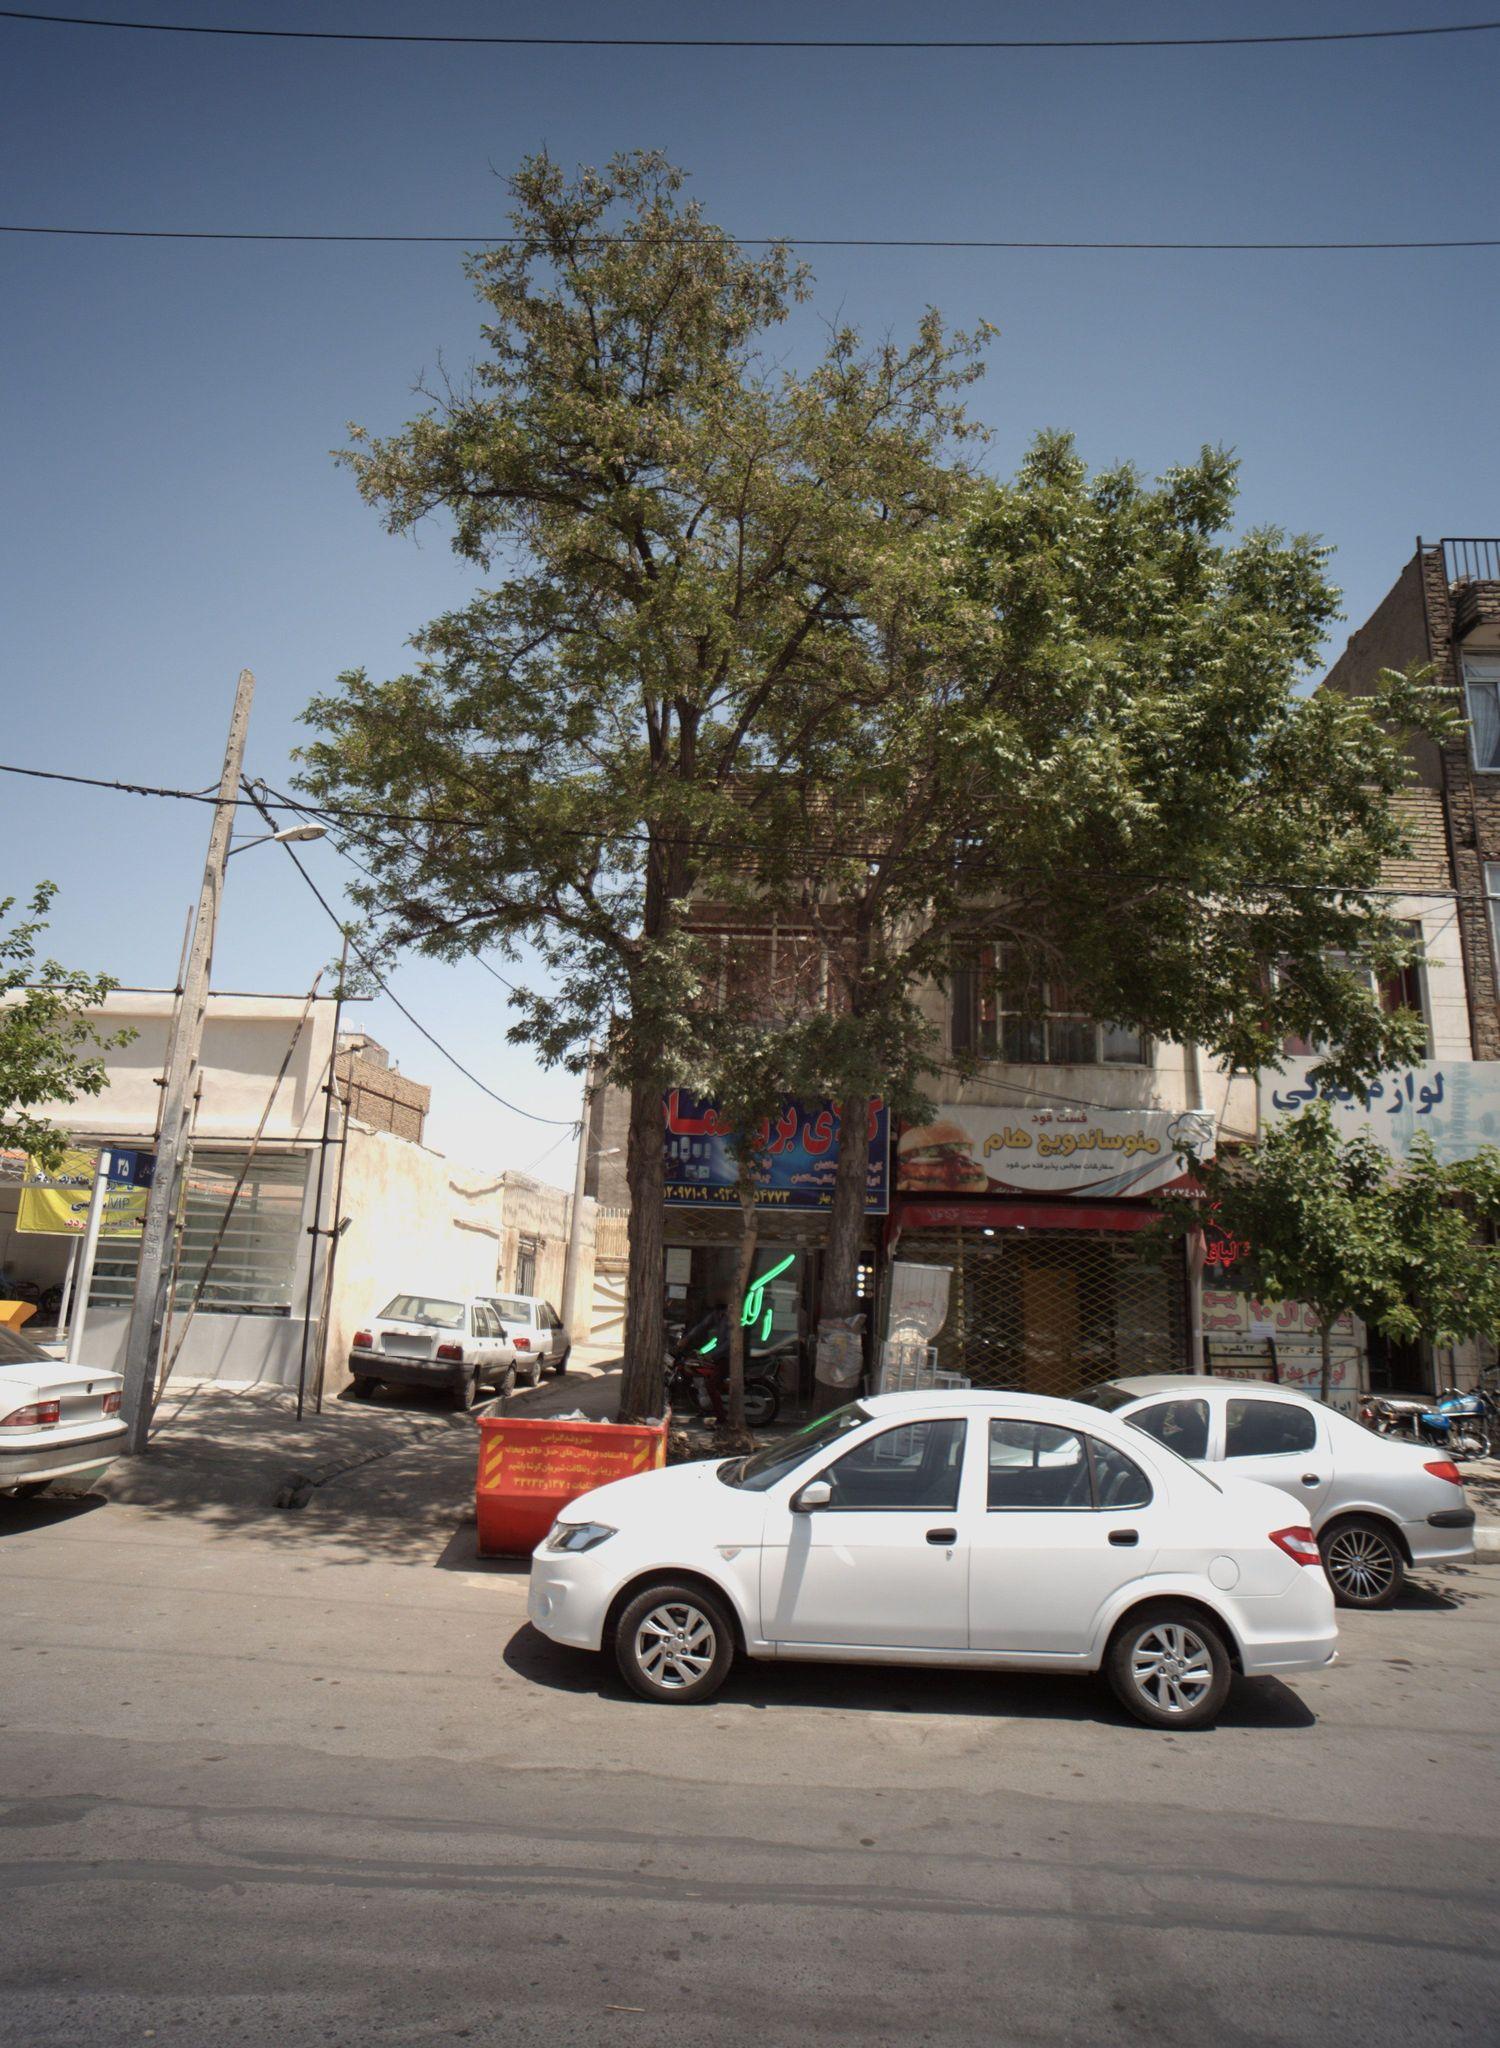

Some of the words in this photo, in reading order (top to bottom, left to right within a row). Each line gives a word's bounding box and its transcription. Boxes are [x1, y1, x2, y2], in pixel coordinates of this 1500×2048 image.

[1031, 1112, 1053, 1126] فود
[1056, 1112, 1088, 1124] فست
[983, 1126, 1033, 1158] هام
[1059, 1161, 1082, 1171] مجالس
